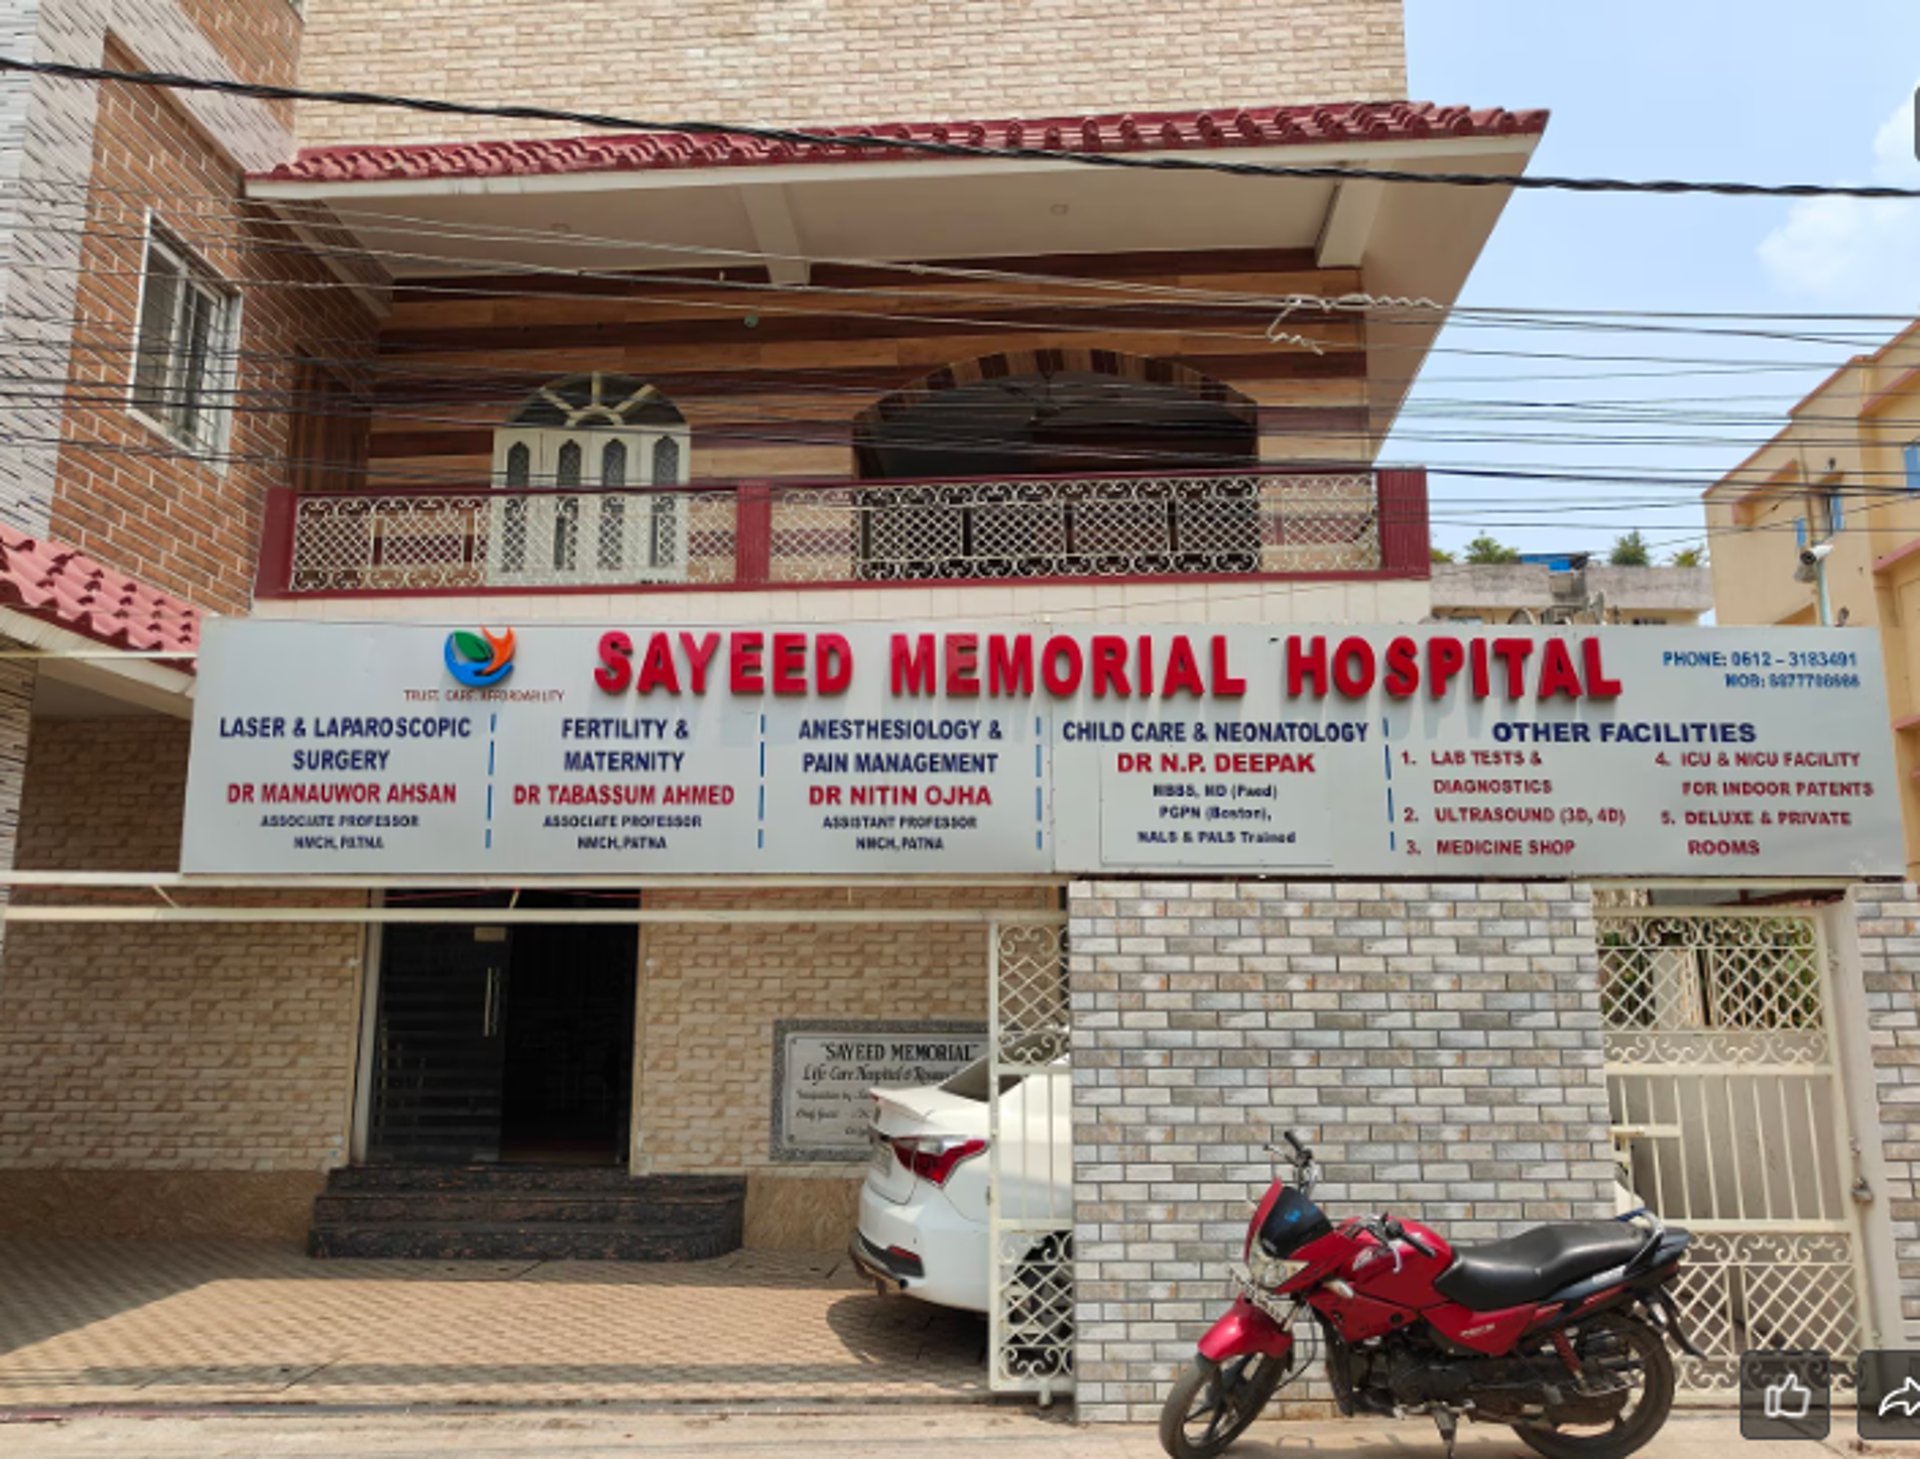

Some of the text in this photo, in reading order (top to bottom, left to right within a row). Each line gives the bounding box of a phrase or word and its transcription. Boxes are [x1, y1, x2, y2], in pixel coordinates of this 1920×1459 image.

[593, 629, 1623, 698] SAYEED MEMORIAL HOSPITAL
[1662, 650, 1728, 668] PHONE:
[1730, 650, 1773, 668] 0612
[219, 715, 473, 739] LASER & LAPAROSCOPIC
[560, 717, 691, 741] FERTILITY &
[797, 718, 1003, 741] ANESTHESIOLOGY &
[1062, 720, 1369, 743] CHILD CARE & NEONATOLOGY
[1491, 721, 1758, 744] OTHER FACILITIES
[291, 748, 391, 772] SURGERY
[563, 749, 686, 773] MATERNITY
[802, 751, 1000, 774] PAIN MANAGEMENT
[1116, 751, 1317, 774] DR N.P. DEEPAK
[1400, 749, 1543, 767] 1. LAB TESTS &
[1654, 751, 1861, 768] 4. ICU & NICU FACILITY
[226, 782, 457, 805] DR MANAUWOR AHSAN
[512, 783, 735, 807] DR TABASSUM AHMED
[808, 784, 993, 807] DR NITIN OJHA
[1432, 778, 1553, 795] DIAGNOSTICS
[1681, 780, 1875, 797] FOR INDOOR PATENTS
[259, 813, 420, 829] ASSOCIATE PROFESSOR
[542, 814, 702, 829] ASSOCIATE PROFESSOR
[822, 814, 978, 830] ASSISTANT PROFESSOR
[1158, 804, 1202, 820] PGPN
[1403, 806, 1627, 827] 2. ULTRASOUND (3D, 4D)
[1660, 809, 1852, 827] 5. DELUXE & PRIVATE
[1136, 830, 1297, 844] NALS & PALS Trained
[1406, 838, 1576, 857] 3. MEDICINE SHOP
[1687, 839, 1761, 857] ROOMS
